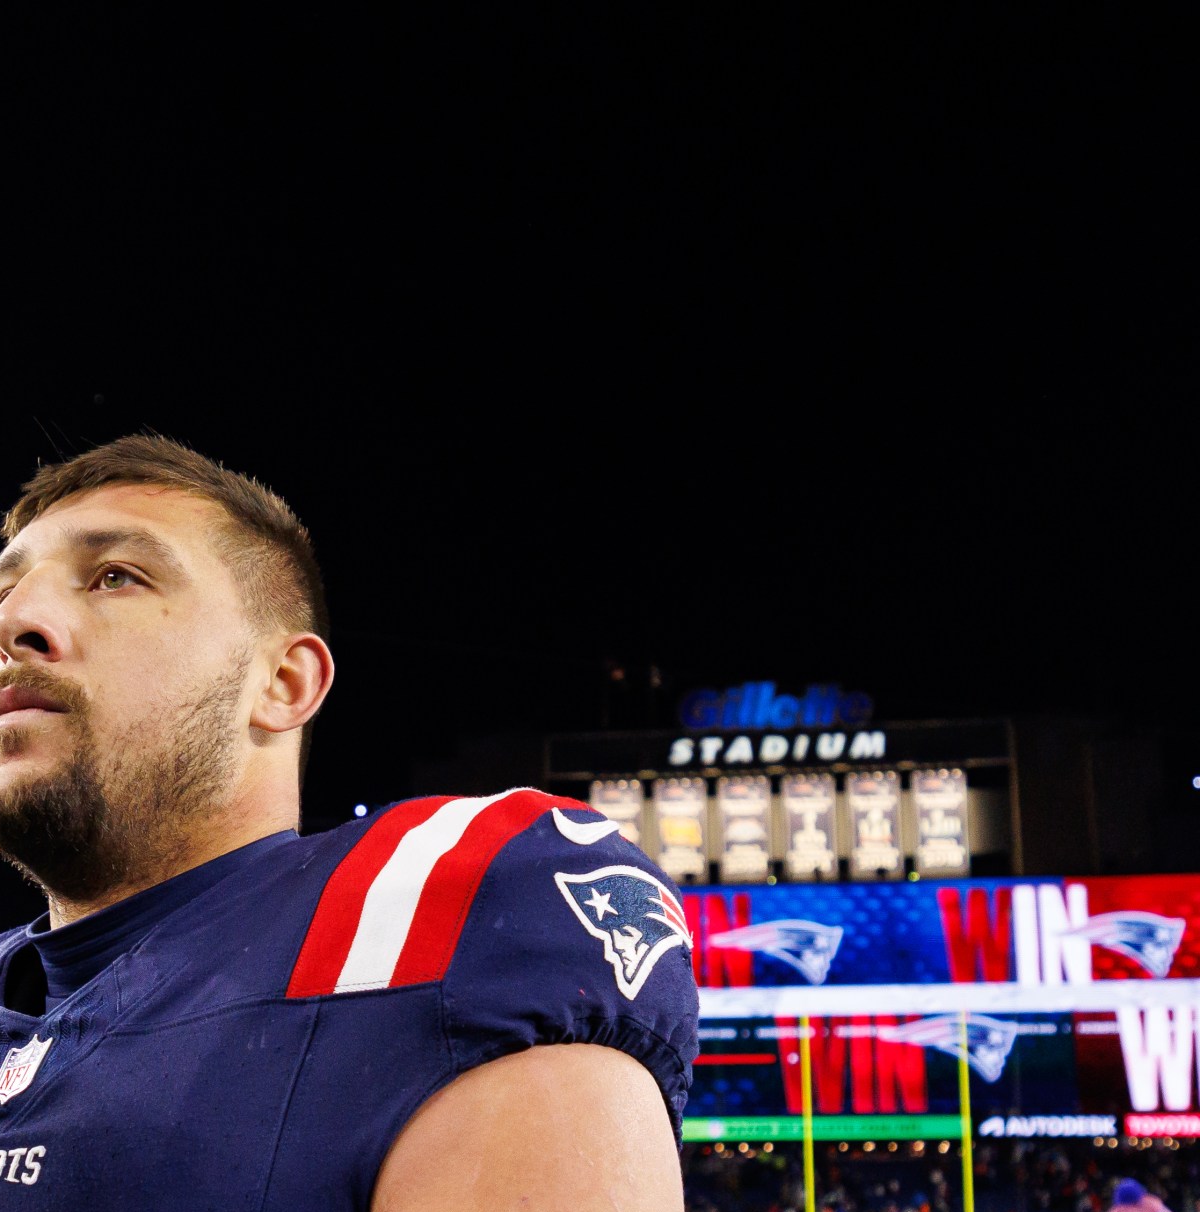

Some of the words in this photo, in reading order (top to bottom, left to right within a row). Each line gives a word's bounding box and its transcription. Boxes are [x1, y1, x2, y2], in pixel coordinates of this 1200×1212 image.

[668, 730, 886, 766] STADIUM
[683, 892, 753, 987] IN
[937, 884, 1092, 984] WIN
[0, 1063, 31, 1090] NFL
[774, 1014, 929, 1114] WIN
[1006, 1115, 1117, 1137] AUTODESK
